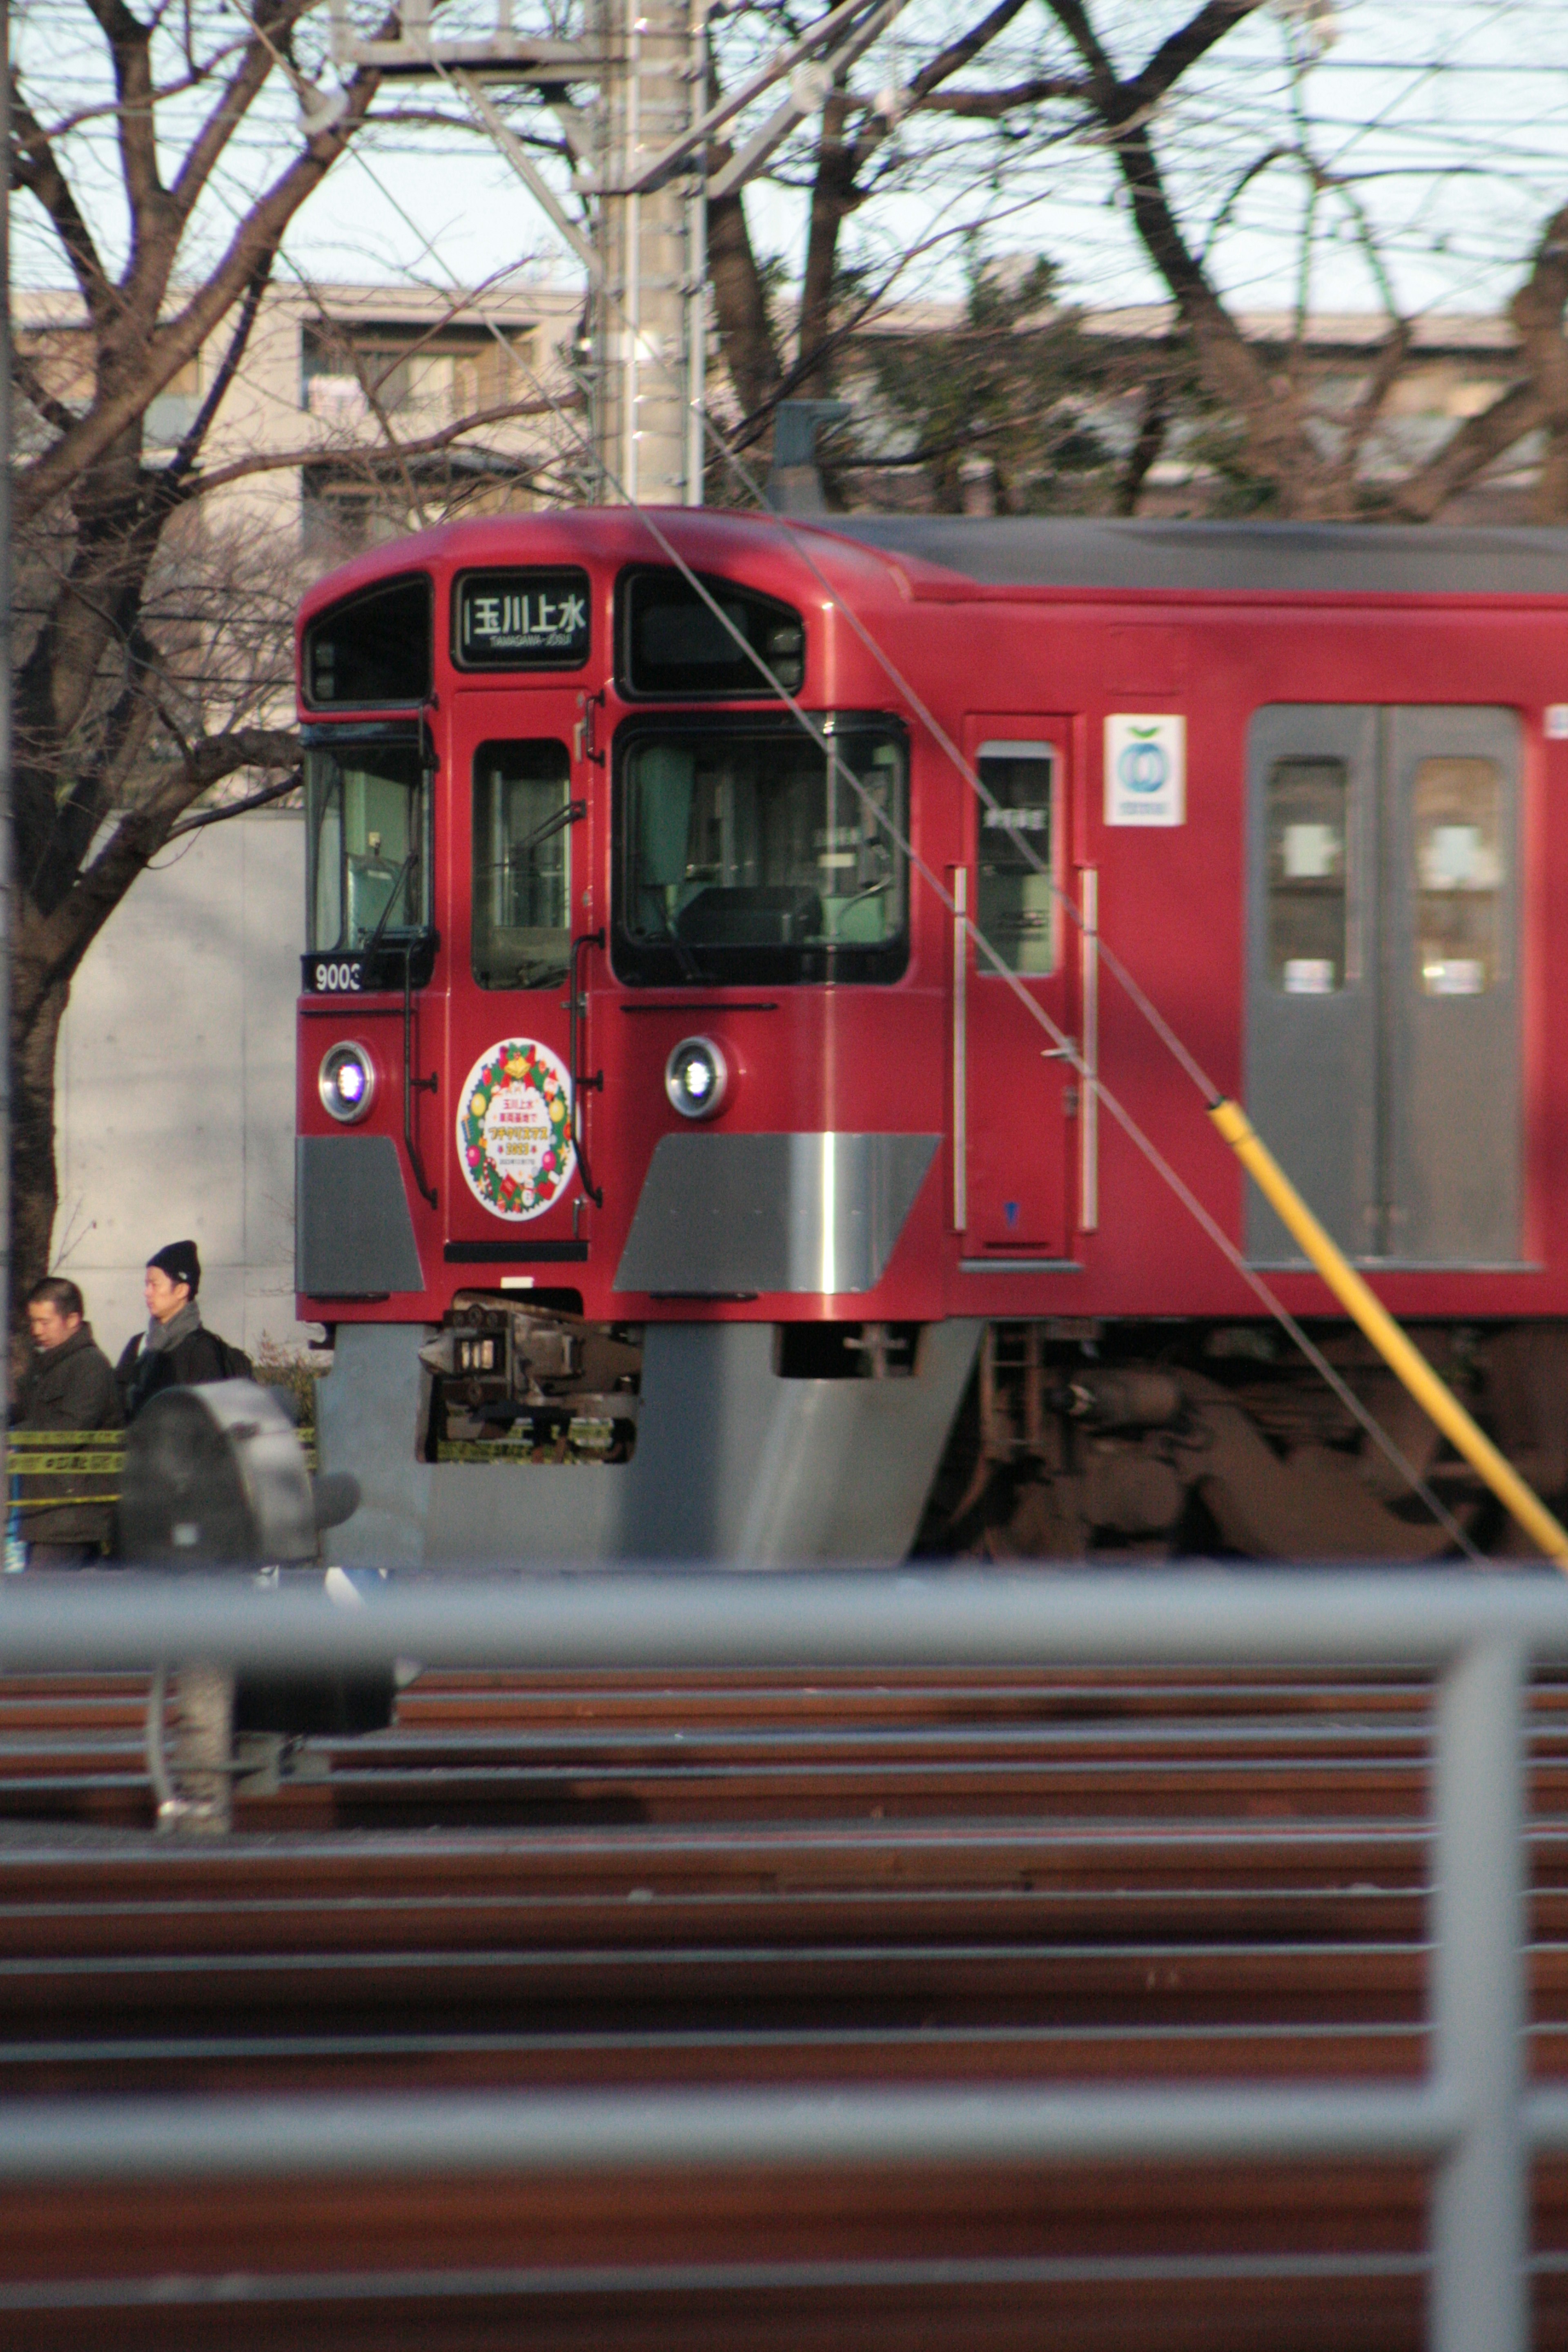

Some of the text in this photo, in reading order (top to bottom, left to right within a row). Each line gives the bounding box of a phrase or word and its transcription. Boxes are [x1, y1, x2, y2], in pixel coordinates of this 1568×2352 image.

[473, 594, 586, 634] 玉川上水
[503, 1099, 533, 1109] 玉川上水
